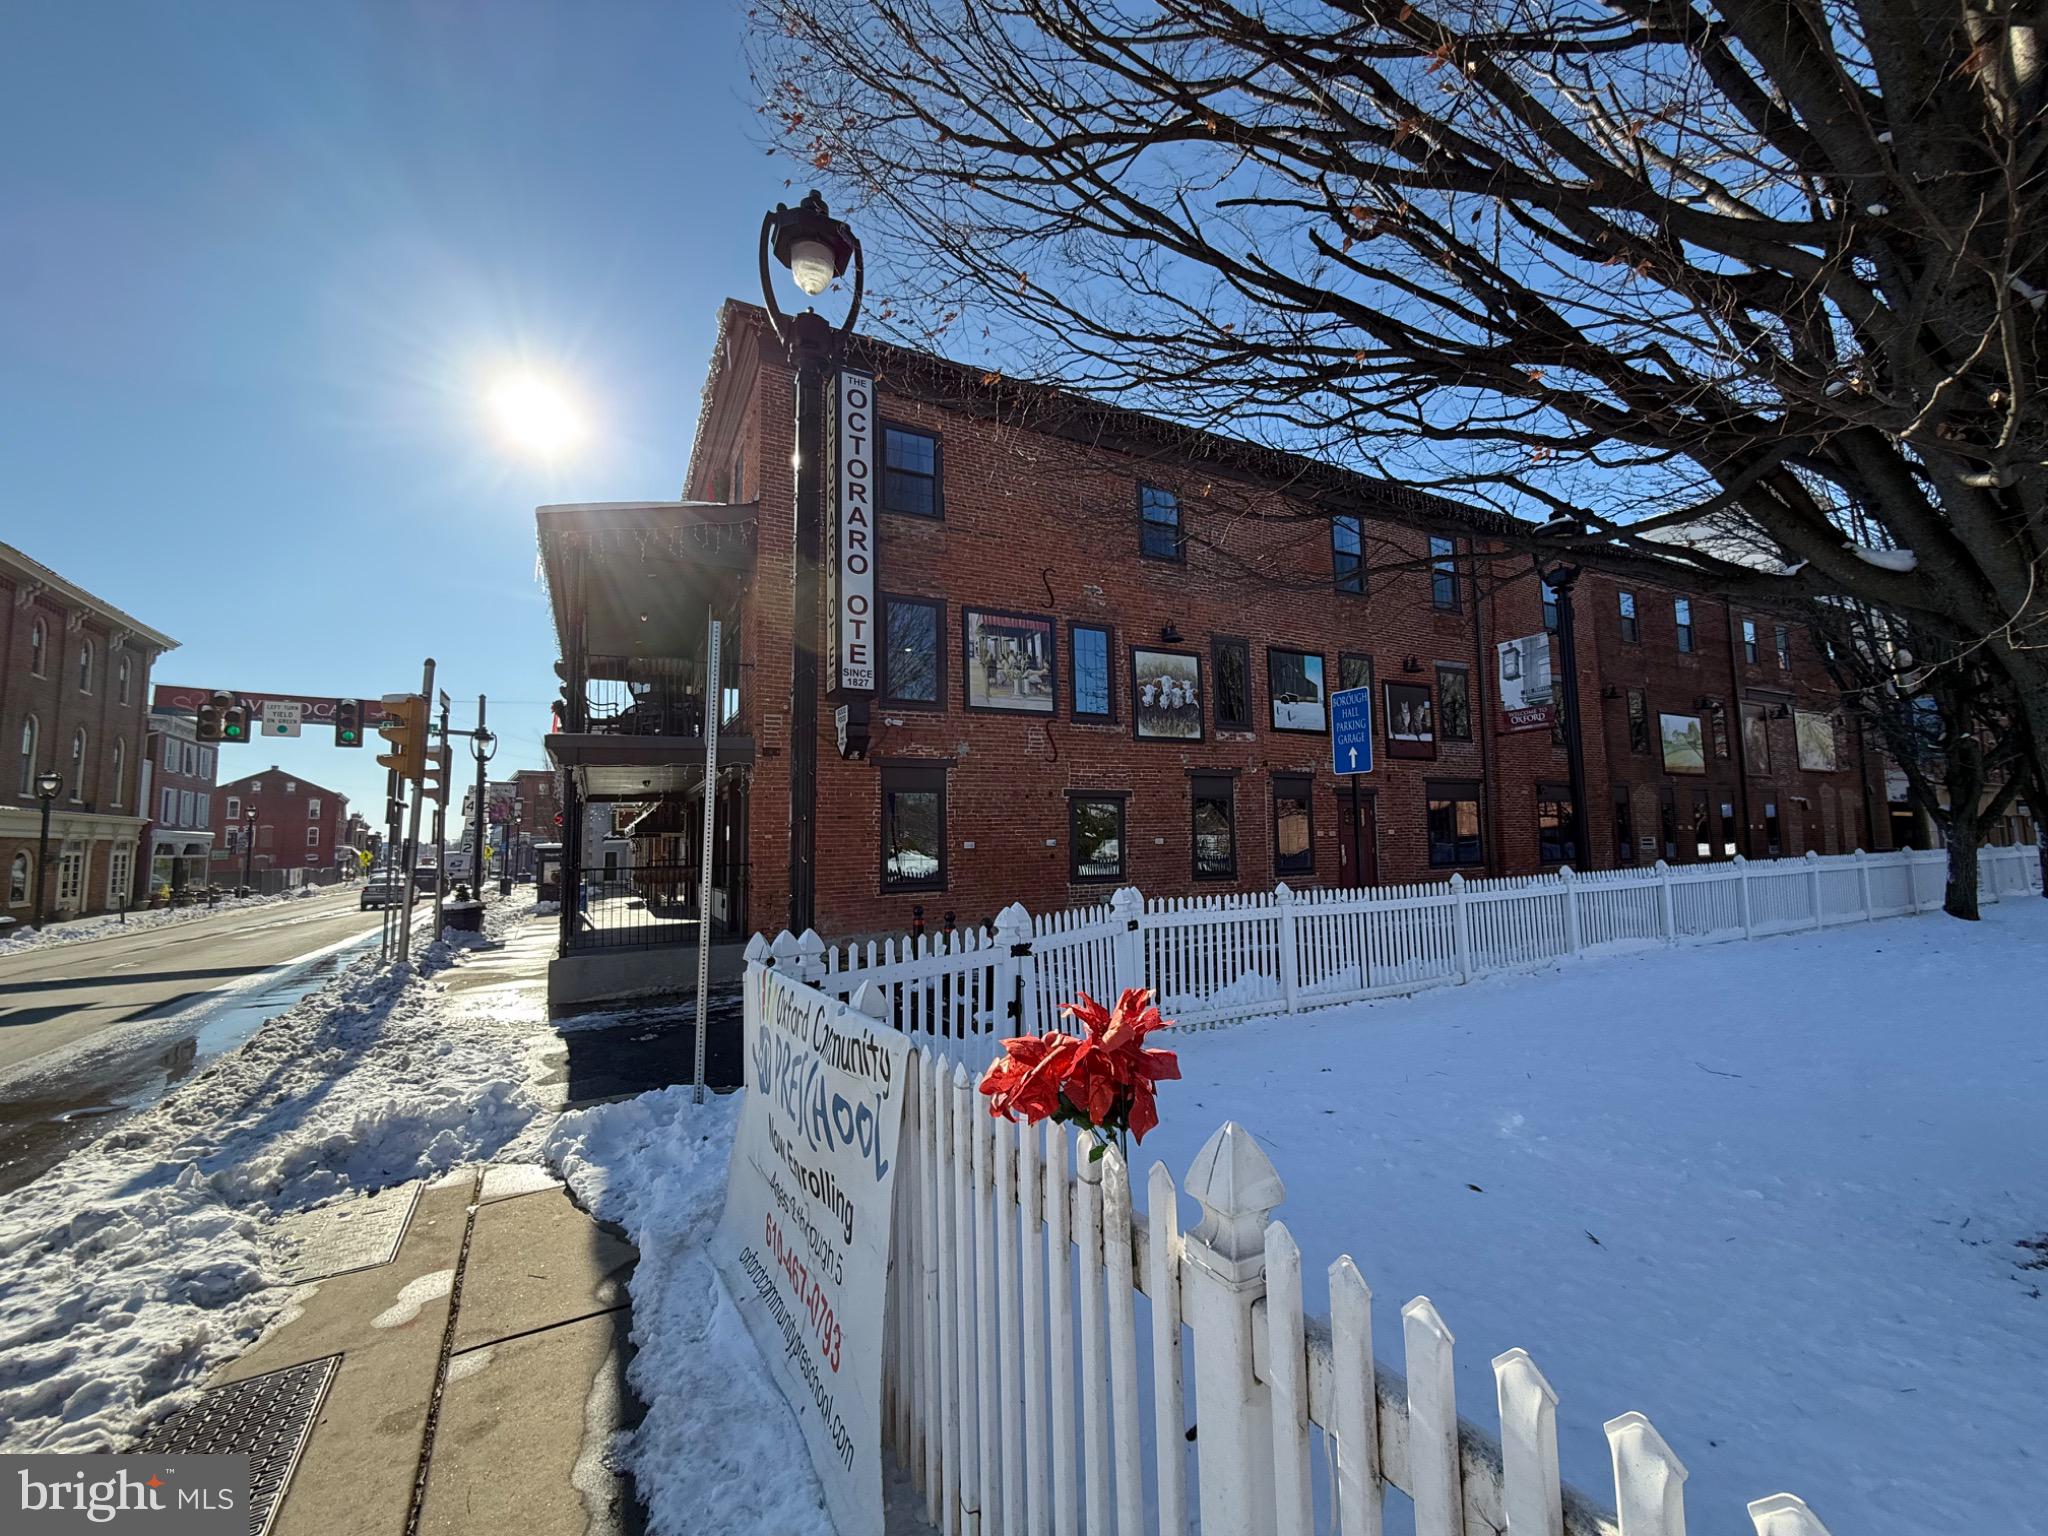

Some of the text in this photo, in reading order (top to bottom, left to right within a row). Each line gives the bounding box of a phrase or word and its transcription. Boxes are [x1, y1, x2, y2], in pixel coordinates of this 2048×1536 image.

[848, 376, 867, 388] THE
[847, 389, 868, 665] OCTORARO OTE
[843, 668, 873, 679] SINCE
[847, 677, 869, 688] 1827
[1333, 691, 1367, 708] BOROUGH
[1342, 707, 1360, 719] HALL
[1511, 713, 1546, 725] OXFORD
[1336, 718, 1366, 732] PARKING
[1338, 732, 1365, 745] GARAGE
[777, 986, 811, 1042] Oxford
[769, 1112, 854, 1245] Now Enrolling
[769, 1171, 788, 1214] Ages
[835, 1253, 843, 1286] 5
[765, 1212, 841, 1373] 610-467-0793
[739, 1247, 855, 1473] oxfordcommunitypreschool.com
